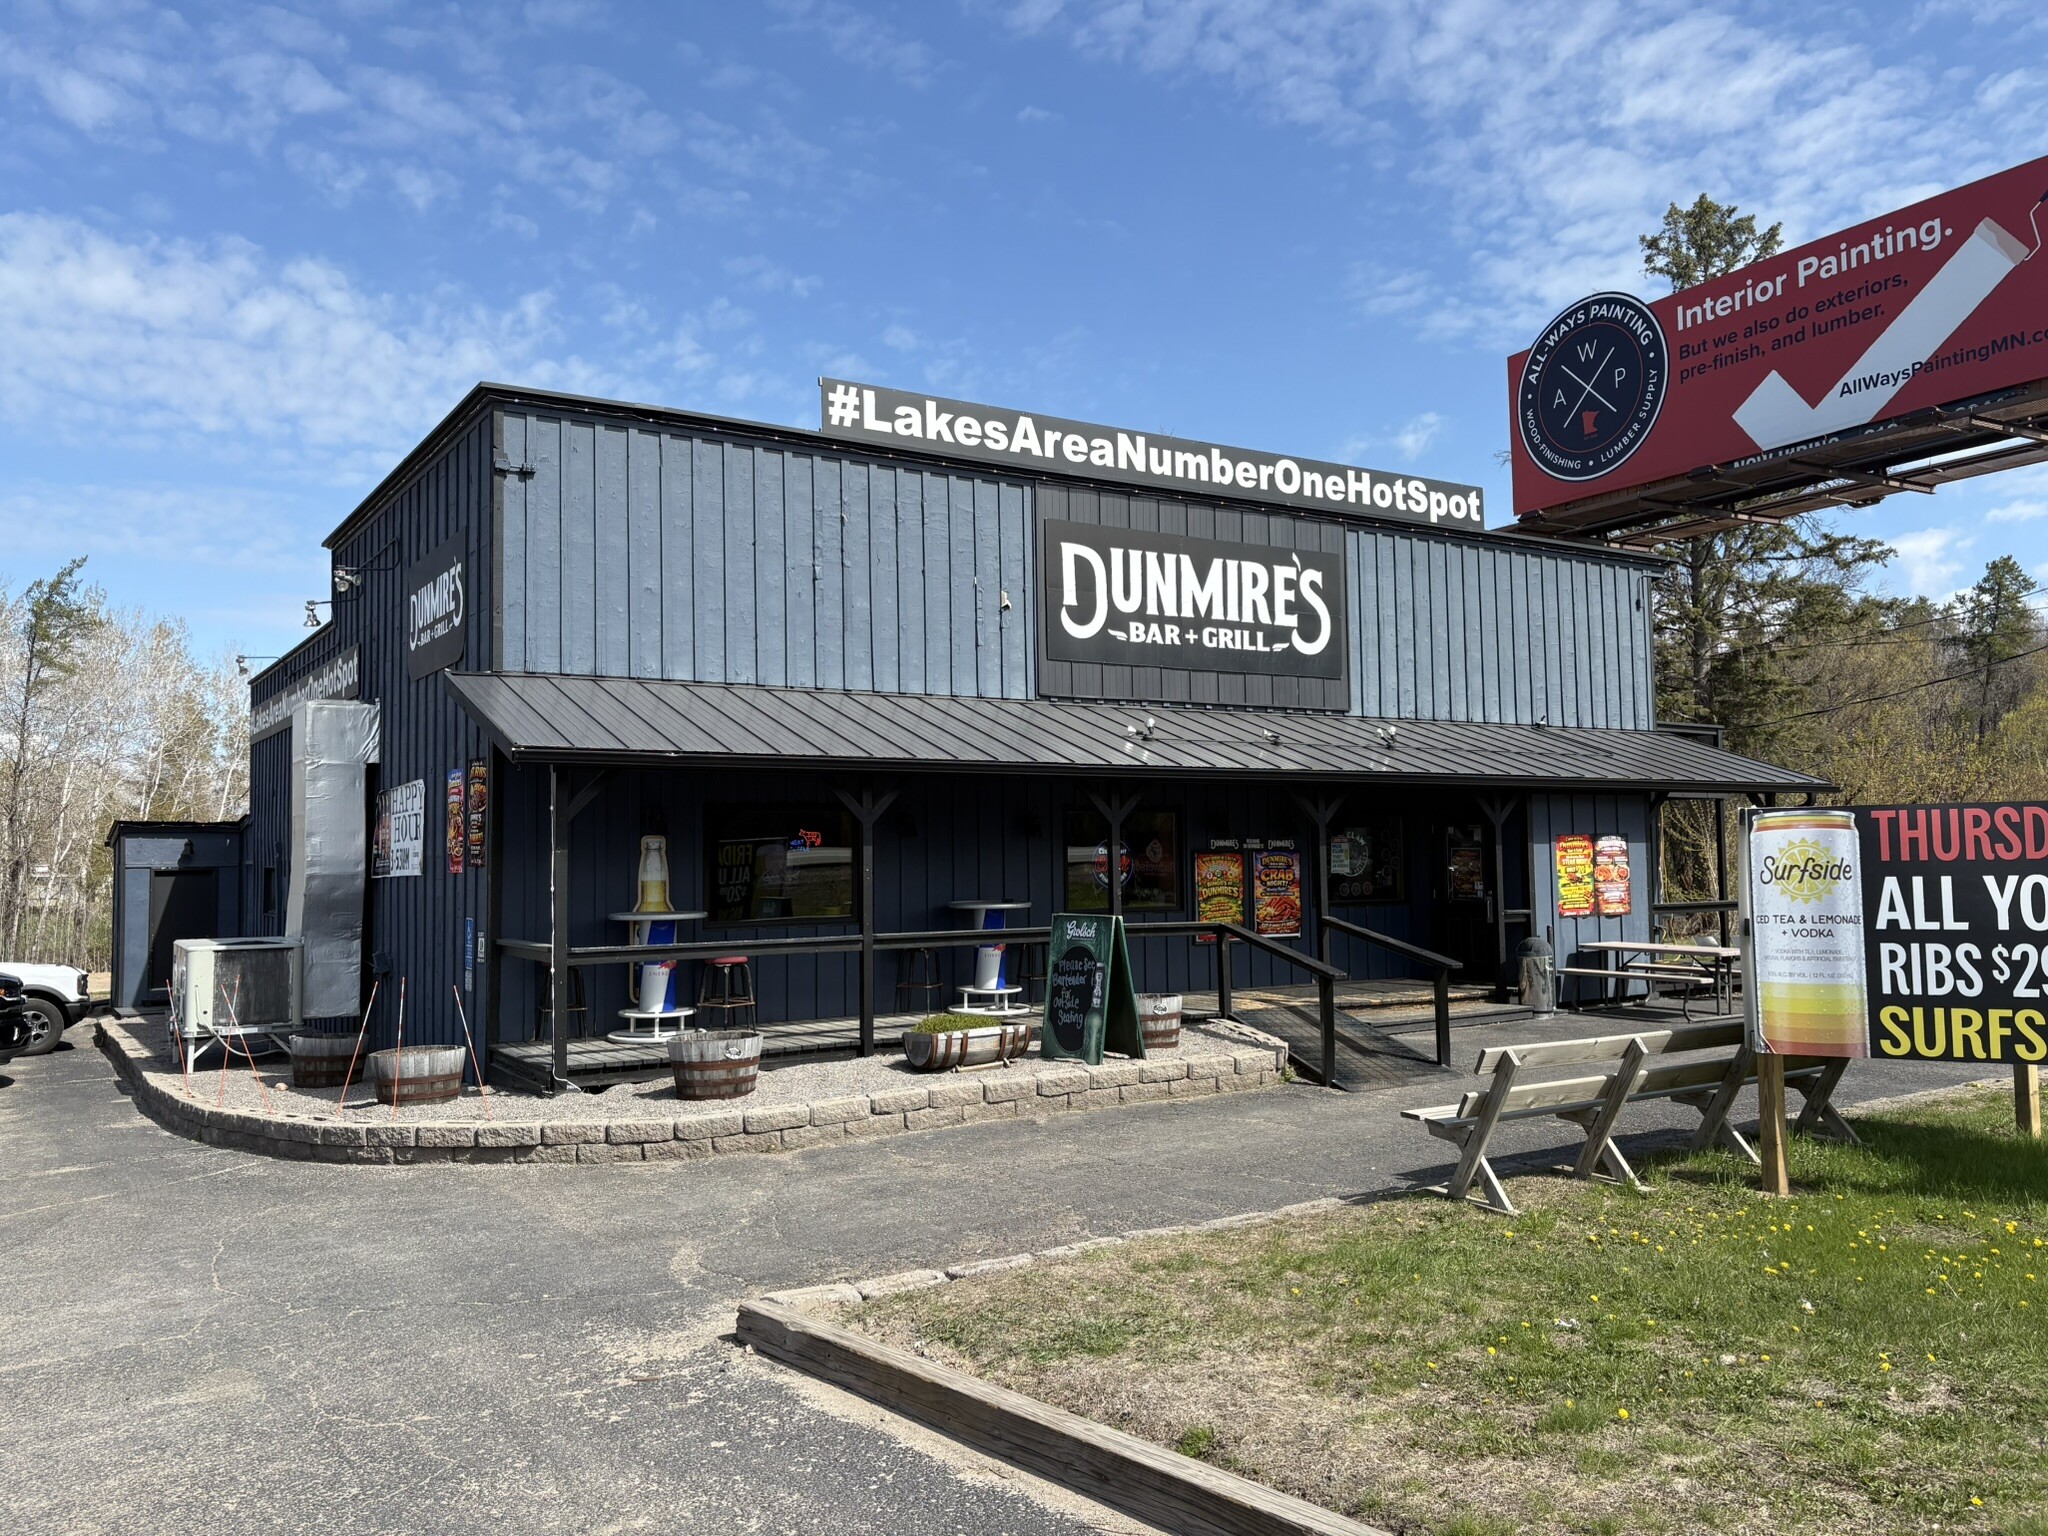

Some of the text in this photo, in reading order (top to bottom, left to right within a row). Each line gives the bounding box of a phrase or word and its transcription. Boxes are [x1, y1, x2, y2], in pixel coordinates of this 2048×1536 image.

[1677, 217, 1953, 331] Interior Painting.
[1679, 273, 1909, 361] But we also do exteriors,
[1528, 303, 1653, 385] ALL-WAYS PAINTING
[1576, 338, 1598, 363] W
[1679, 301, 1885, 385] pre-finish, and lumber.
[1614, 367, 1626, 389] P
[1552, 388, 1567, 409] A
[1600, 369, 1658, 463] LUMBER SUPPLY
[828, 384, 1481, 522] #LakesAreaNumberOneHotSpot
[1526, 408, 1582, 470] WOOD-FINISHING
[410, 556, 463, 651] DUNMIRE'S
[1060, 542, 1331, 656] DUNMIRE'S
[420, 629, 431, 647] BAR
[1129, 621, 1180, 646] BAR
[1203, 626, 1272, 652] GRILL
[391, 782, 424, 816] HAPPY
[394, 813, 421, 844] HOUR
[1346, 831, 1367, 847] CLAW
[1261, 869, 1294, 881] CRAB
[1760, 856, 1853, 885] Surfside
[1875, 876, 1969, 931] ALL
[1067, 920, 1098, 940] Grolsch
[1772, 915, 1796, 924] TEA
[1799, 915, 1808, 924] &
[1811, 915, 1862, 925] LEMONADE
[1791, 928, 1835, 938] VODKA
[1053, 974, 1087, 985] Bartender
[1059, 957, 1096, 973] Please See
[1879, 942, 2048, 999] RIBS $2
[1879, 1005, 2048, 1061] SURFS
